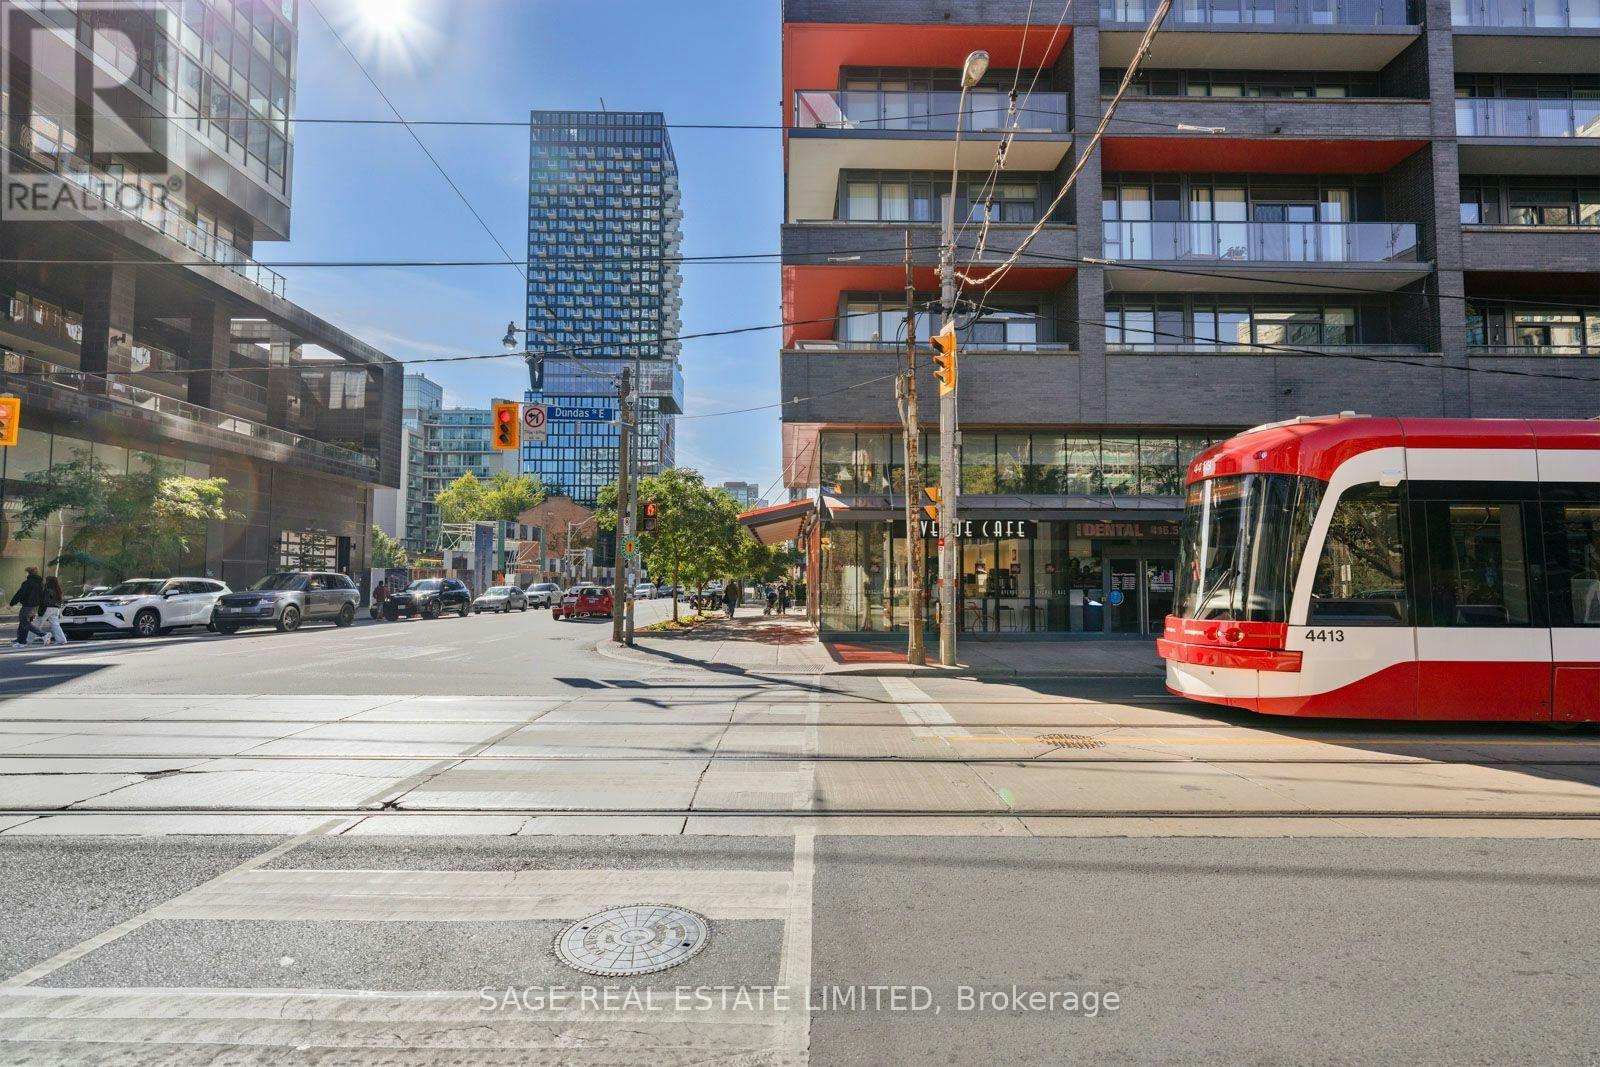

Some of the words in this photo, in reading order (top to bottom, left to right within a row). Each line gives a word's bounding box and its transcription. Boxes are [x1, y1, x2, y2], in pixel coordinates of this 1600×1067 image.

[555, 407, 589, 418] Dundas
[599, 409, 605, 418] E
[919, 520, 973, 537] VEUE
[982, 520, 1025, 537] CAFE
[1305, 629, 1345, 642] 4413
